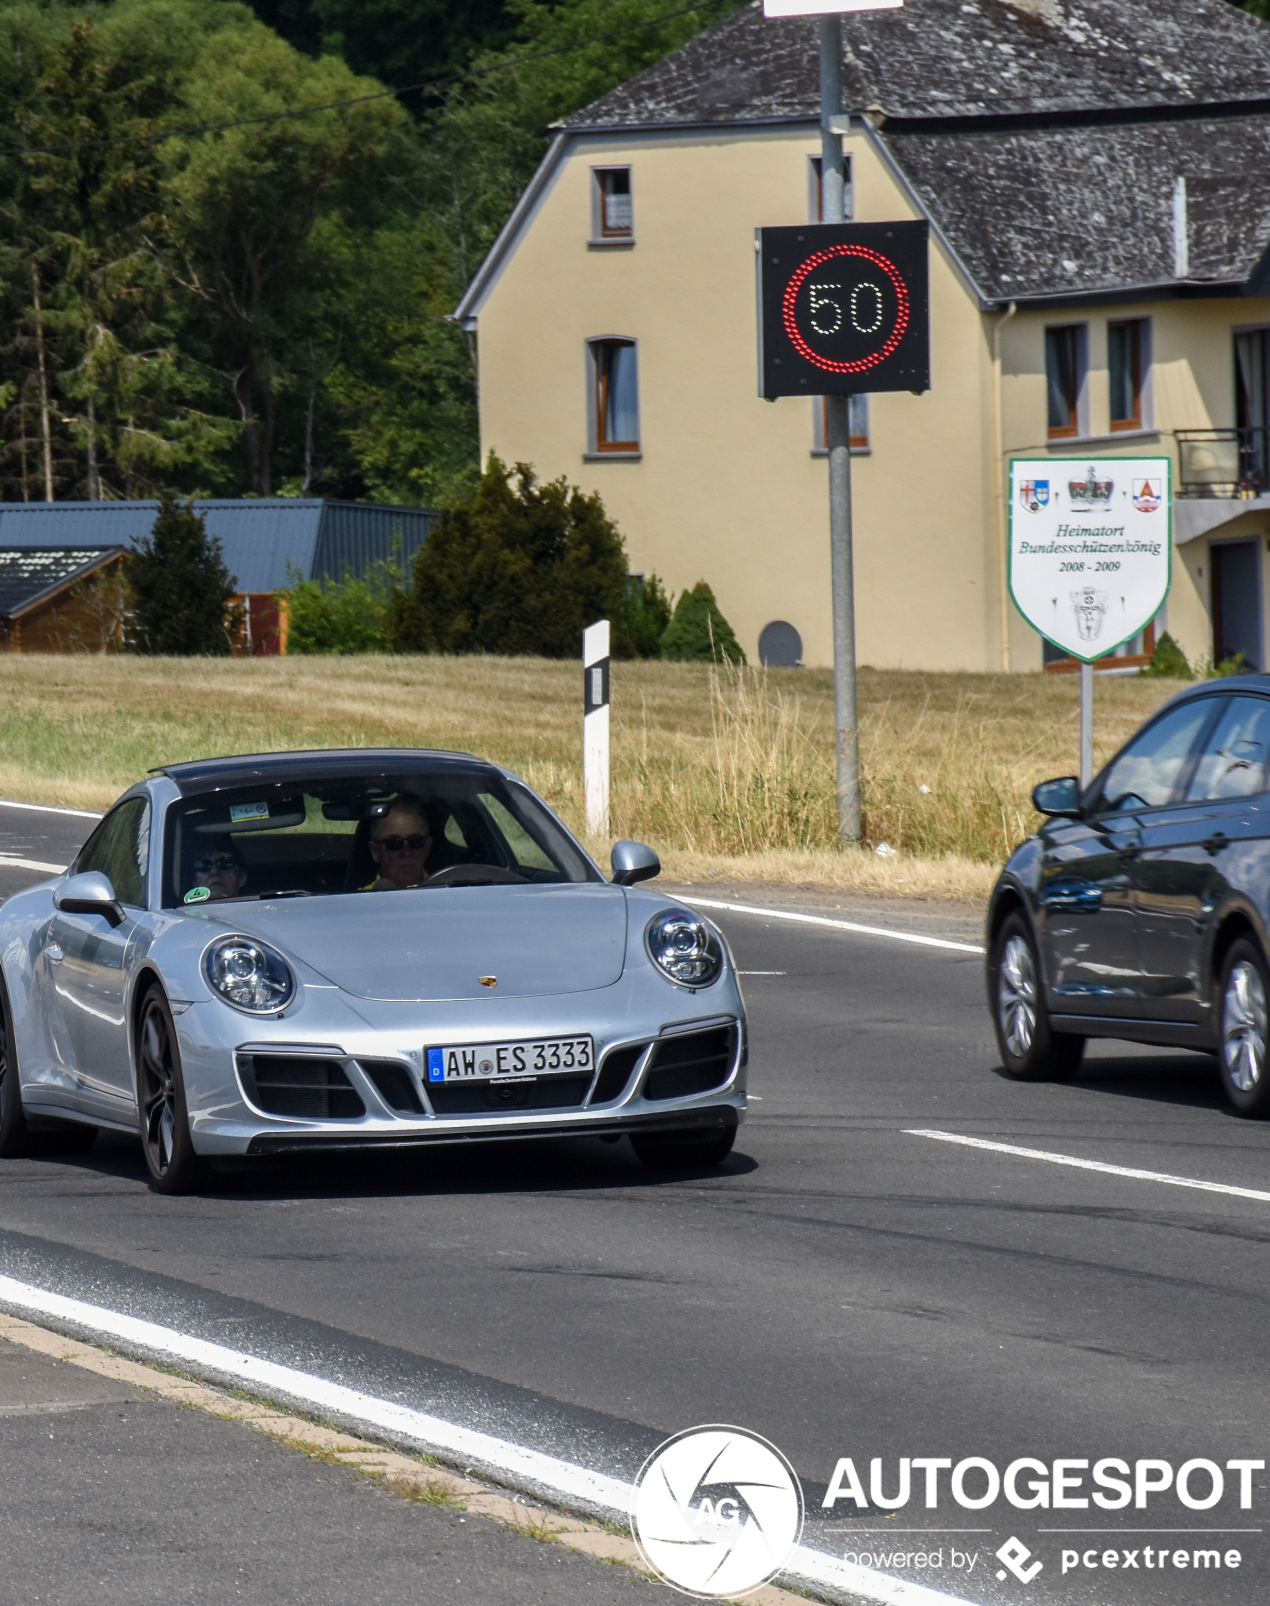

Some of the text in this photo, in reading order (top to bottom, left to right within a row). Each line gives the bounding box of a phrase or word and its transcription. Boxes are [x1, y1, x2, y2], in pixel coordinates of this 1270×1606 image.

[810, 282, 882, 334] 50
[1056, 524, 1125, 537] Heimatort
[1019, 540, 1162, 556] Bundesschützenkönig
[1059, 562, 1085, 572] 2008
[1094, 561, 1121, 572] 2009
[447, 1040, 589, 1077] AW ES 3333
[432, 1067, 440, 1076] D
